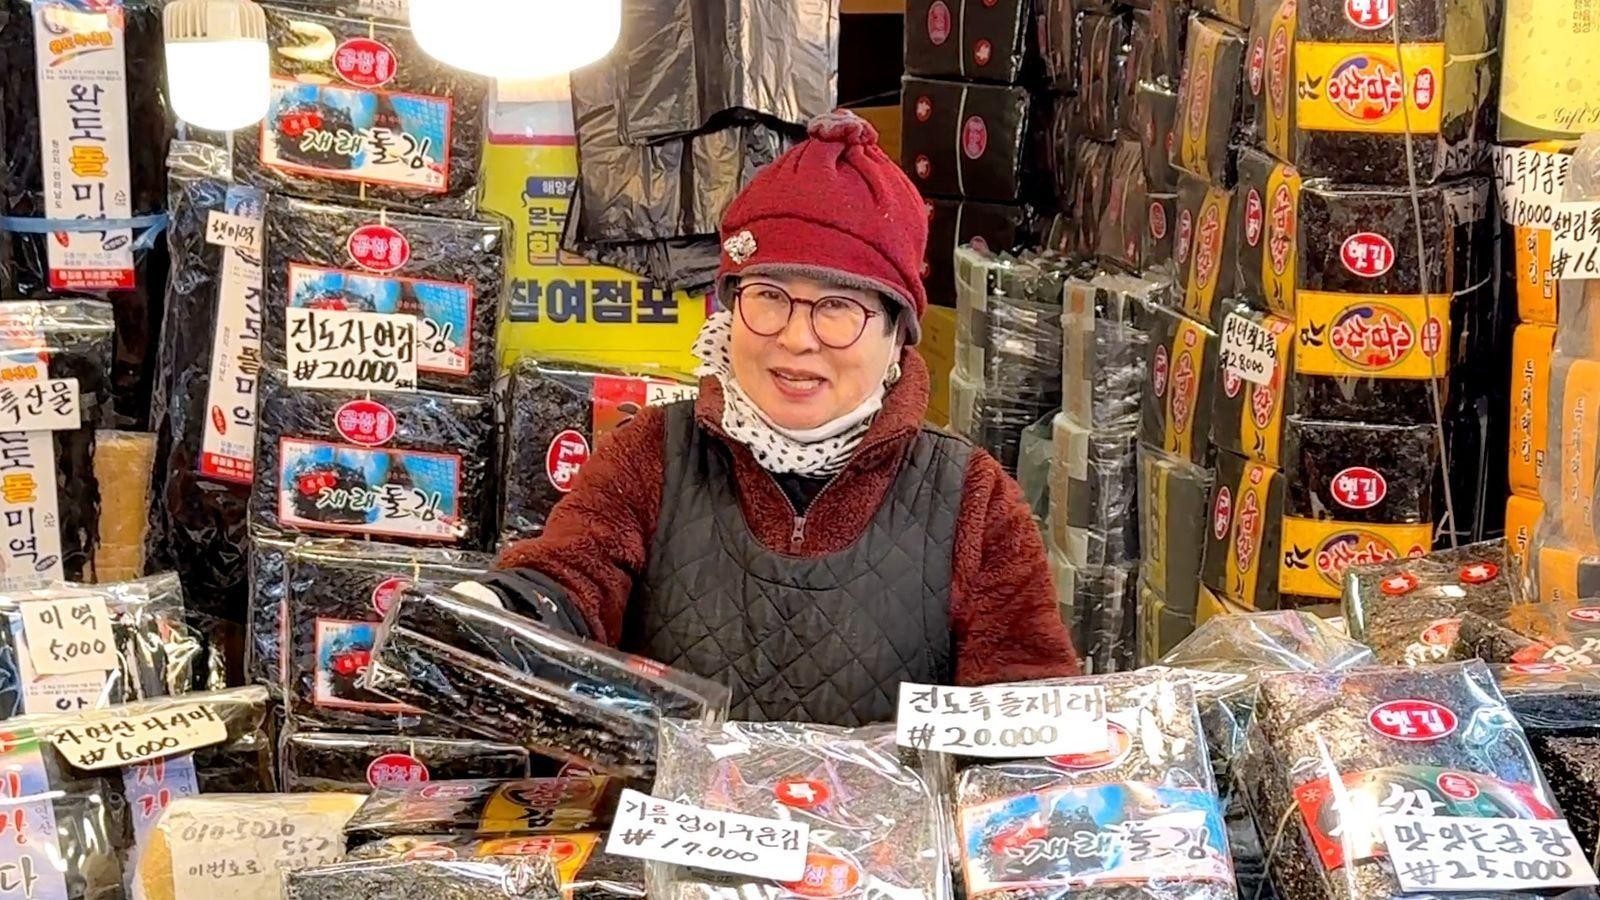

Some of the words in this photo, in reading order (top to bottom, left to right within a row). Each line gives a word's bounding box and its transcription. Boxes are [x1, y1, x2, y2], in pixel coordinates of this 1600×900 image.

[300, 127, 431, 169] 재래돌김
[1349, 240, 1386, 270] 햇김
[290, 311, 414, 363] 진도자연김
[1300, 320, 1326, 346] 김
[1333, 315, 1413, 360] 곱창
[318, 485, 442, 521] 재래돌김
[1338, 476, 1379, 503] 햇김
[1284, 543, 1313, 570] 김
[1376, 707, 1448, 736] 햇김
